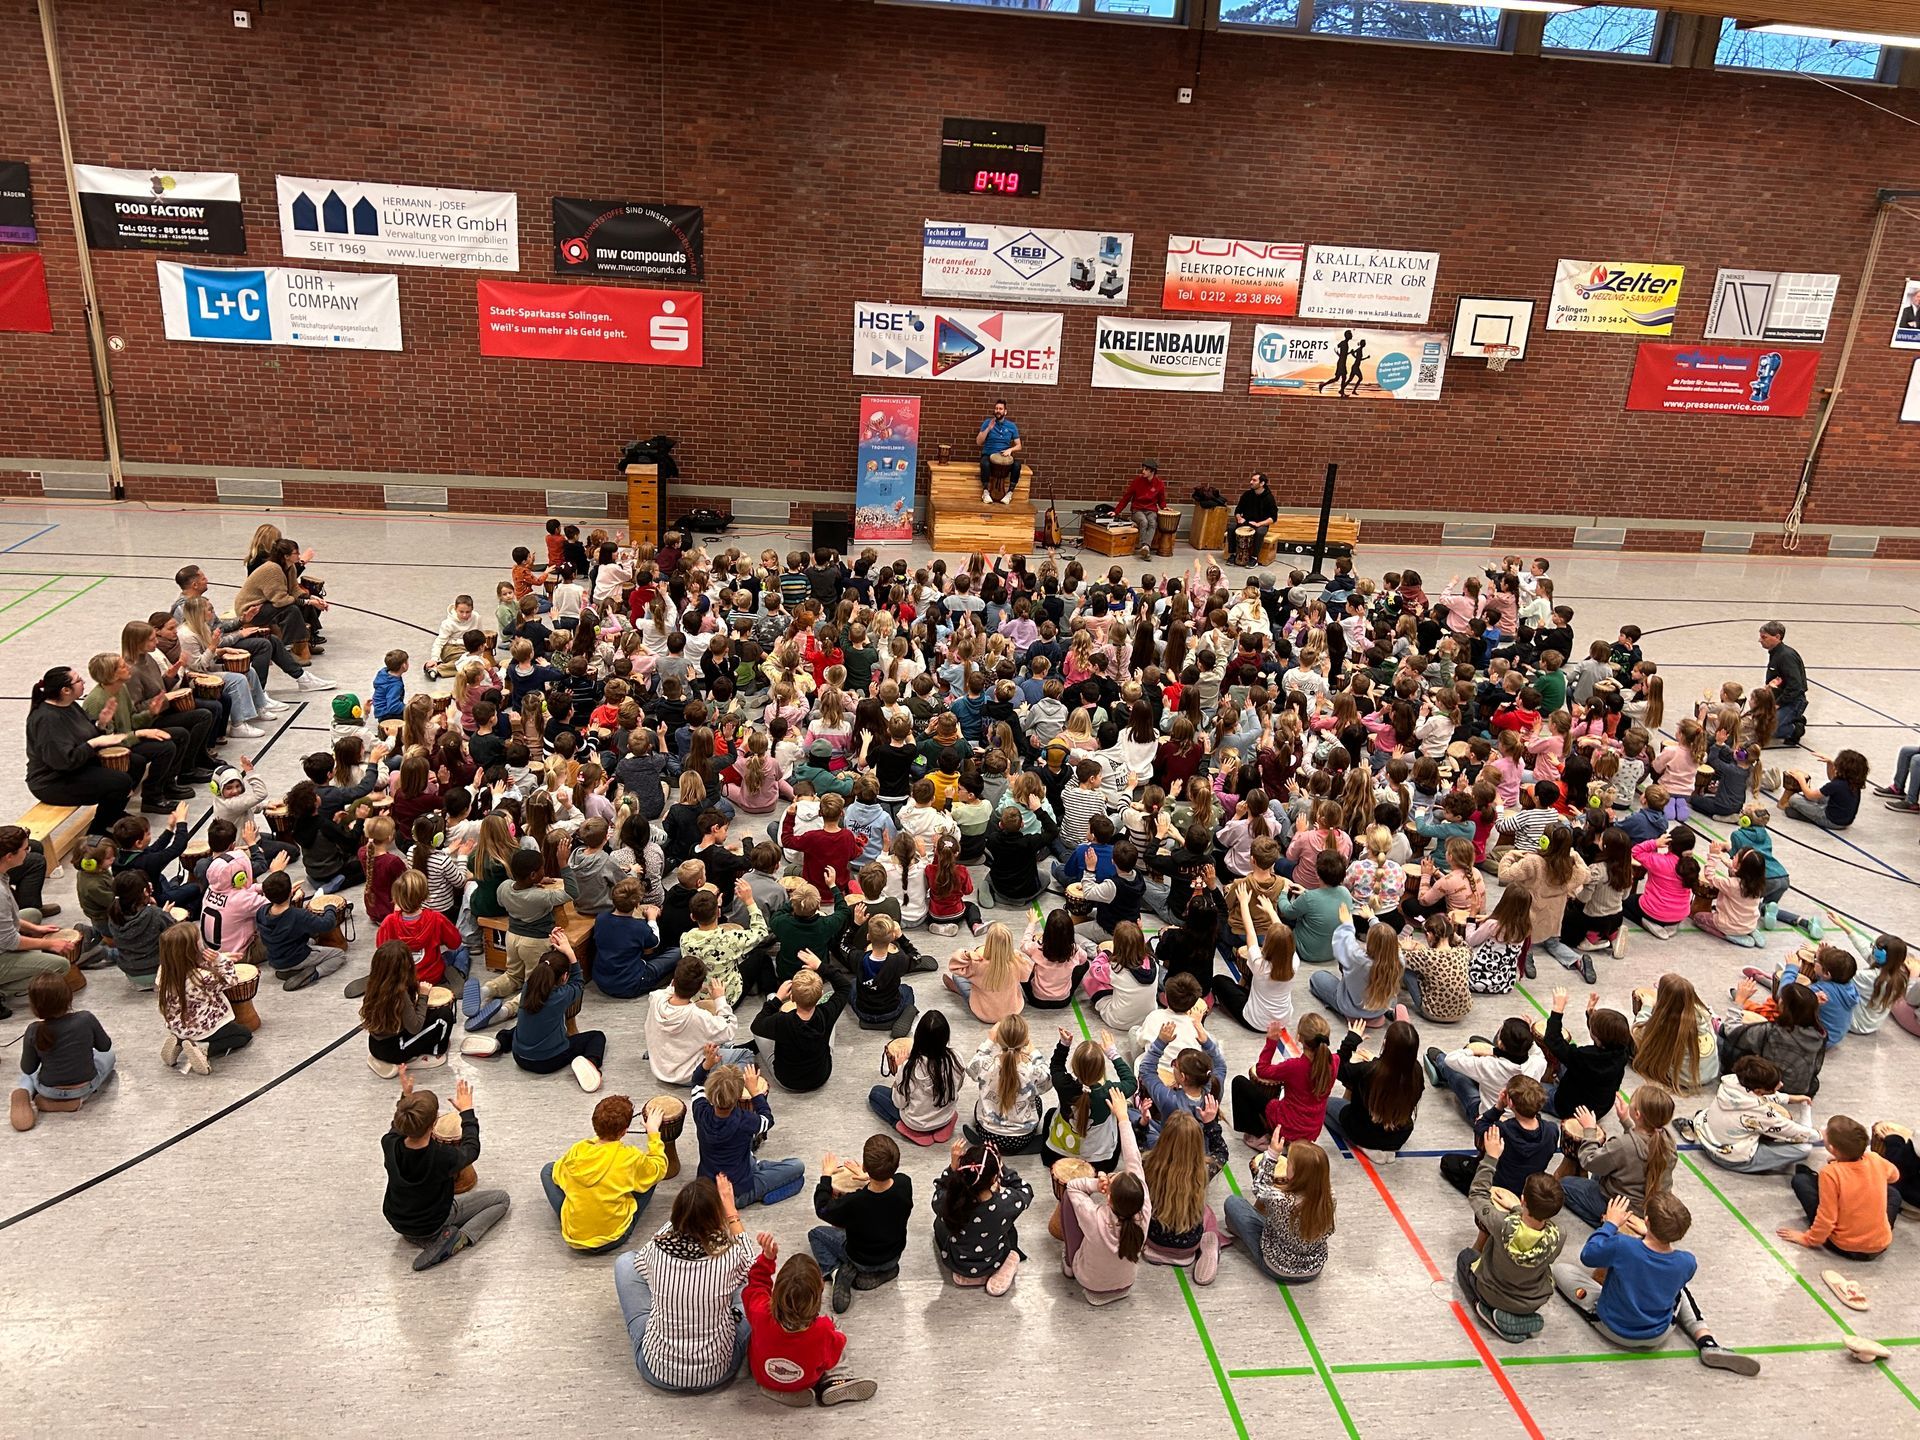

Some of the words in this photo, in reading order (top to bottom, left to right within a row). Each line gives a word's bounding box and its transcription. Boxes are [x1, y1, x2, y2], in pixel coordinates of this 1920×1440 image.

[975, 170, 1018, 192] 8:49
[115, 203, 148, 215] FOOD
[151, 205, 205, 218] FACTORY
[383, 197, 431, 208] HERMANN
[439, 201, 466, 210] JOSEF
[383, 208, 452, 229] LÜRWER
[457, 216, 507, 232] GmbH
[584, 208, 624, 240] KUNSTSTOFFE
[645, 209, 673, 227] UNSERE
[385, 229, 436, 242] Verwaltung
[439, 234, 456, 242] von
[458, 234, 508, 245] Immobilien
[928, 238, 968, 248] kompetenter
[969, 240, 986, 248] Hand.
[310, 242, 334, 252] SEIT
[339, 243, 366, 254] 1969
[387, 248, 508, 263] www.luerwergmbh.de
[1011, 247, 1046, 257] REBI
[1168, 240, 1304, 260] JUNG
[596, 248, 617, 258] mw
[621, 250, 686, 264] compounds
[928, 256, 944, 265] Jetzt
[946, 258, 977, 266] anrufen!
[1013, 258, 1042, 266] Solingen
[1315, 252, 1365, 268] KRALL,
[1369, 255, 1430, 270] KALKUM
[598, 263, 687, 275] www.mwcompounds.de
[942, 266, 959, 274] 0212
[965, 267, 992, 276] 262520
[1181, 263, 1286, 278] ELEKTROTECHNIK
[286, 274, 323, 290] LOHR
[1313, 270, 1323, 280] &
[1332, 271, 1392, 285] PARTNER
[1401, 275, 1426, 287] GbR
[1603, 271, 1677, 293] Zelter
[197, 286, 260, 322] L+C
[288, 293, 358, 310] COMPANY
[1178, 289, 1195, 300] Tel.
[1235, 292, 1247, 302] 23
[1250, 294, 1261, 303] 38
[1264, 294, 1282, 304] 896
[490, 306, 566, 320] Stadt-Sparkasse
[568, 311, 612, 322] Solingen.
[1557, 305, 1587, 314] Solingen
[490, 322, 519, 333] Weil's
[539, 326, 563, 335] mehr
[565, 327, 578, 336] als
[580, 328, 601, 337] Geld
[604, 329, 627, 339] geht.
[858, 332, 925, 342] INGENIEURE
[1100, 330, 1225, 354] KREIENBAUM
[1289, 340, 1328, 350] SPORTS
[1150, 355, 1222, 366] NEOSCIENCE
[1289, 350, 1314, 359] TIME
[990, 371, 1054, 381] INGENIEURE
[1663, 400, 1769, 411] www.pressenservice.com
